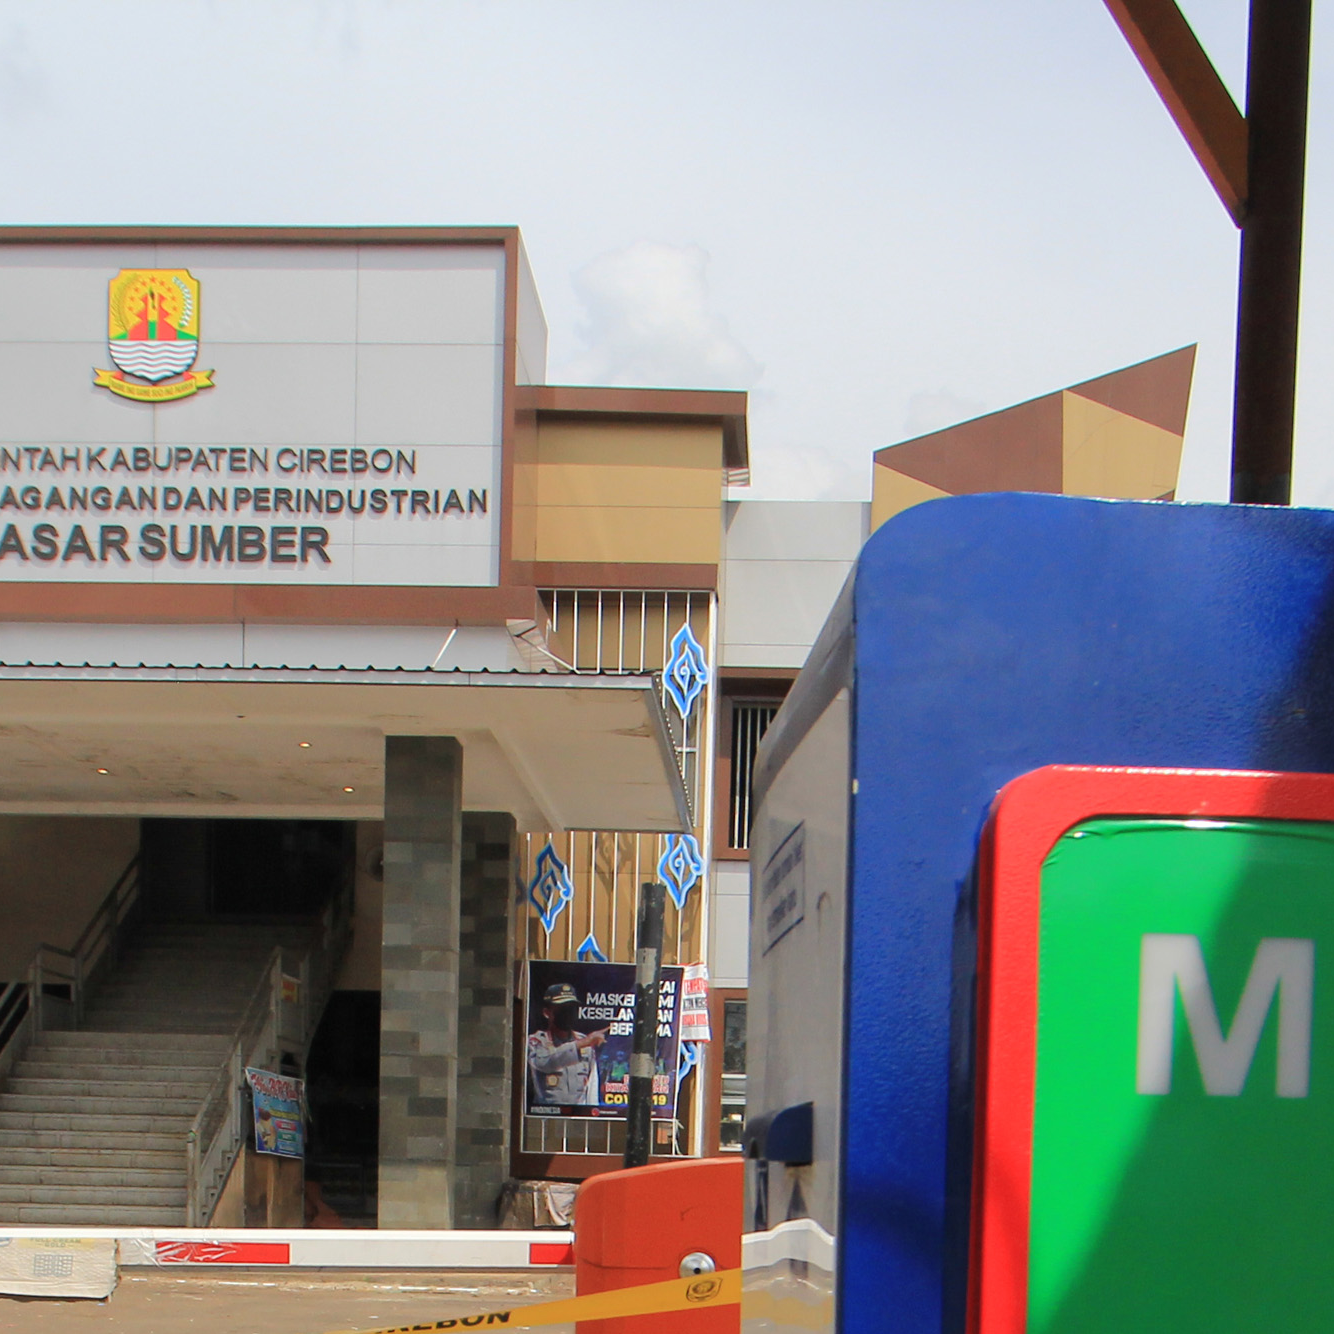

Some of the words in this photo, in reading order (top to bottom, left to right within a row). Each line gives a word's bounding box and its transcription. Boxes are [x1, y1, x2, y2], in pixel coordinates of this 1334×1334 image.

[87, 446, 269, 473] KABUPATEN
[276, 448, 416, 474] CIREBON
[163, 486, 227, 511] DAN
[234, 487, 488, 514] PERINDUSTRIAN
[139, 523, 332, 563] SUMBER
